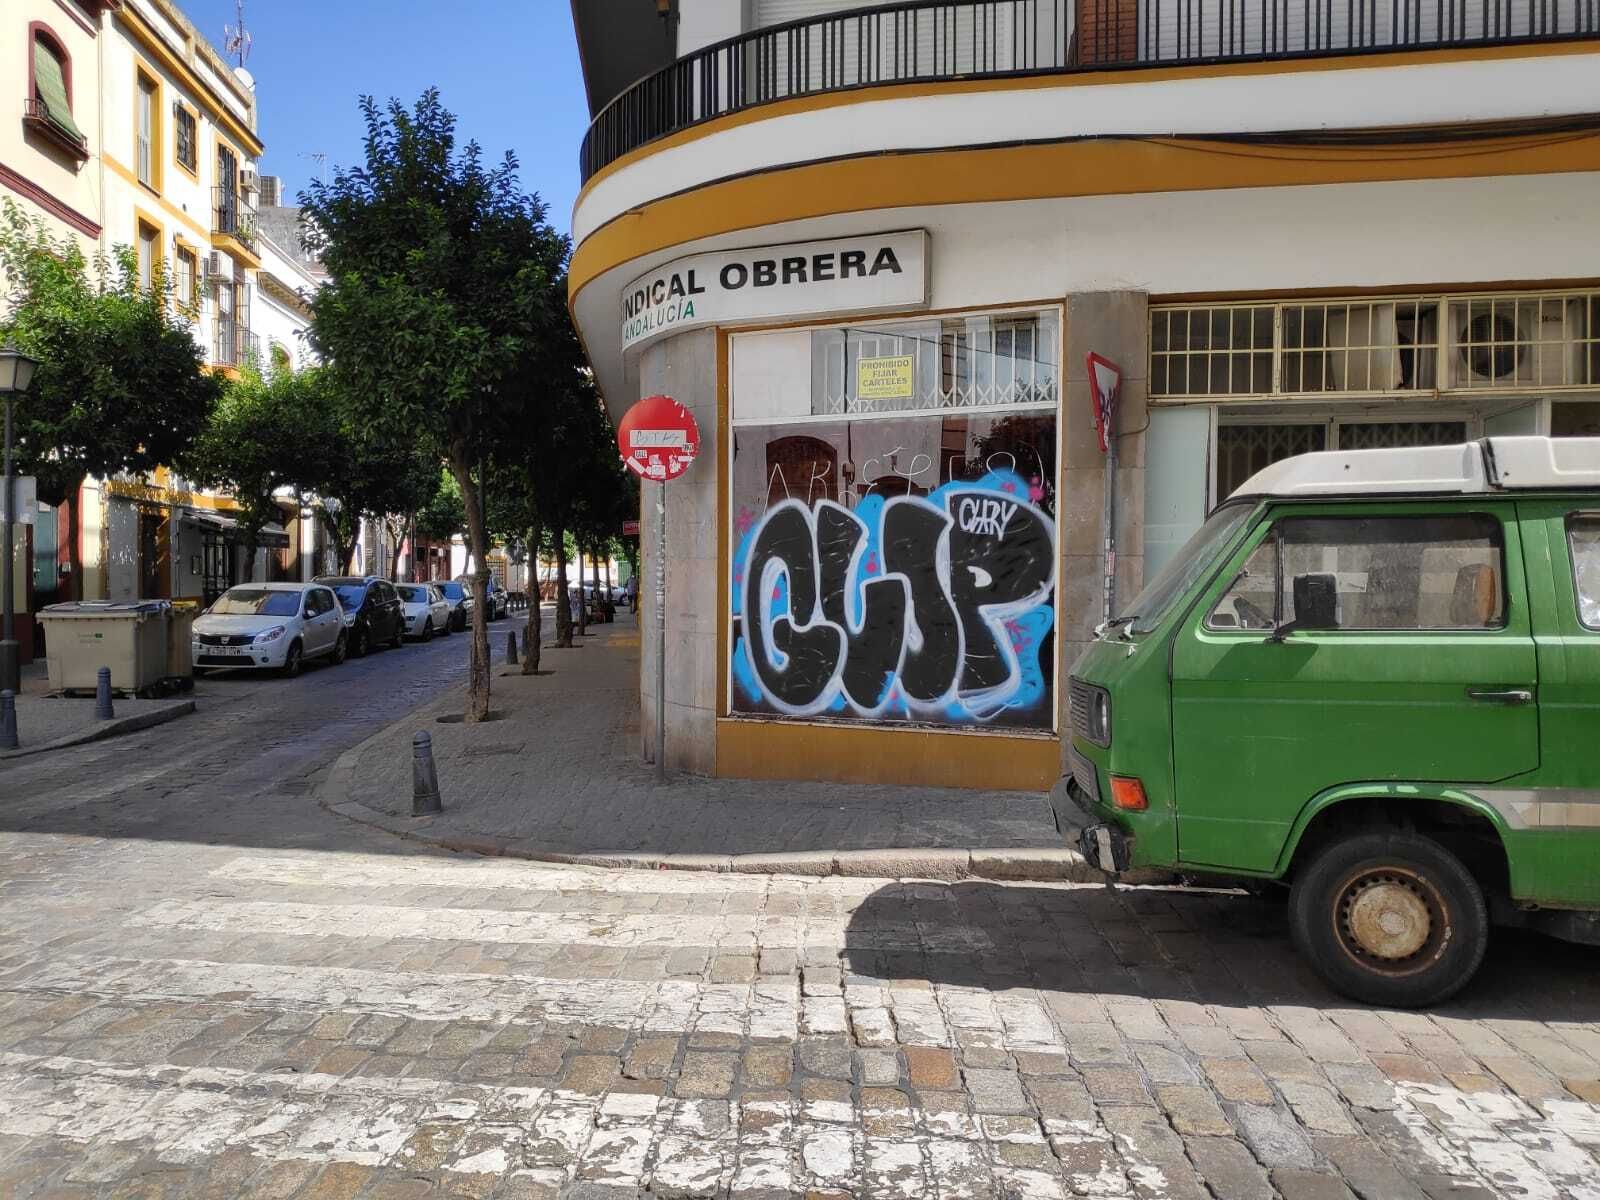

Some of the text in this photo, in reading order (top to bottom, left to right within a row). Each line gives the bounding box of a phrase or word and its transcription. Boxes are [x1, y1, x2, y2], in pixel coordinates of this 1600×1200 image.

[719, 247, 902, 290] OBRERA
[861, 359, 909, 369] PROHIBIDO
[873, 369, 897, 377] FIJAR
[863, 377, 907, 387] CARTELES
